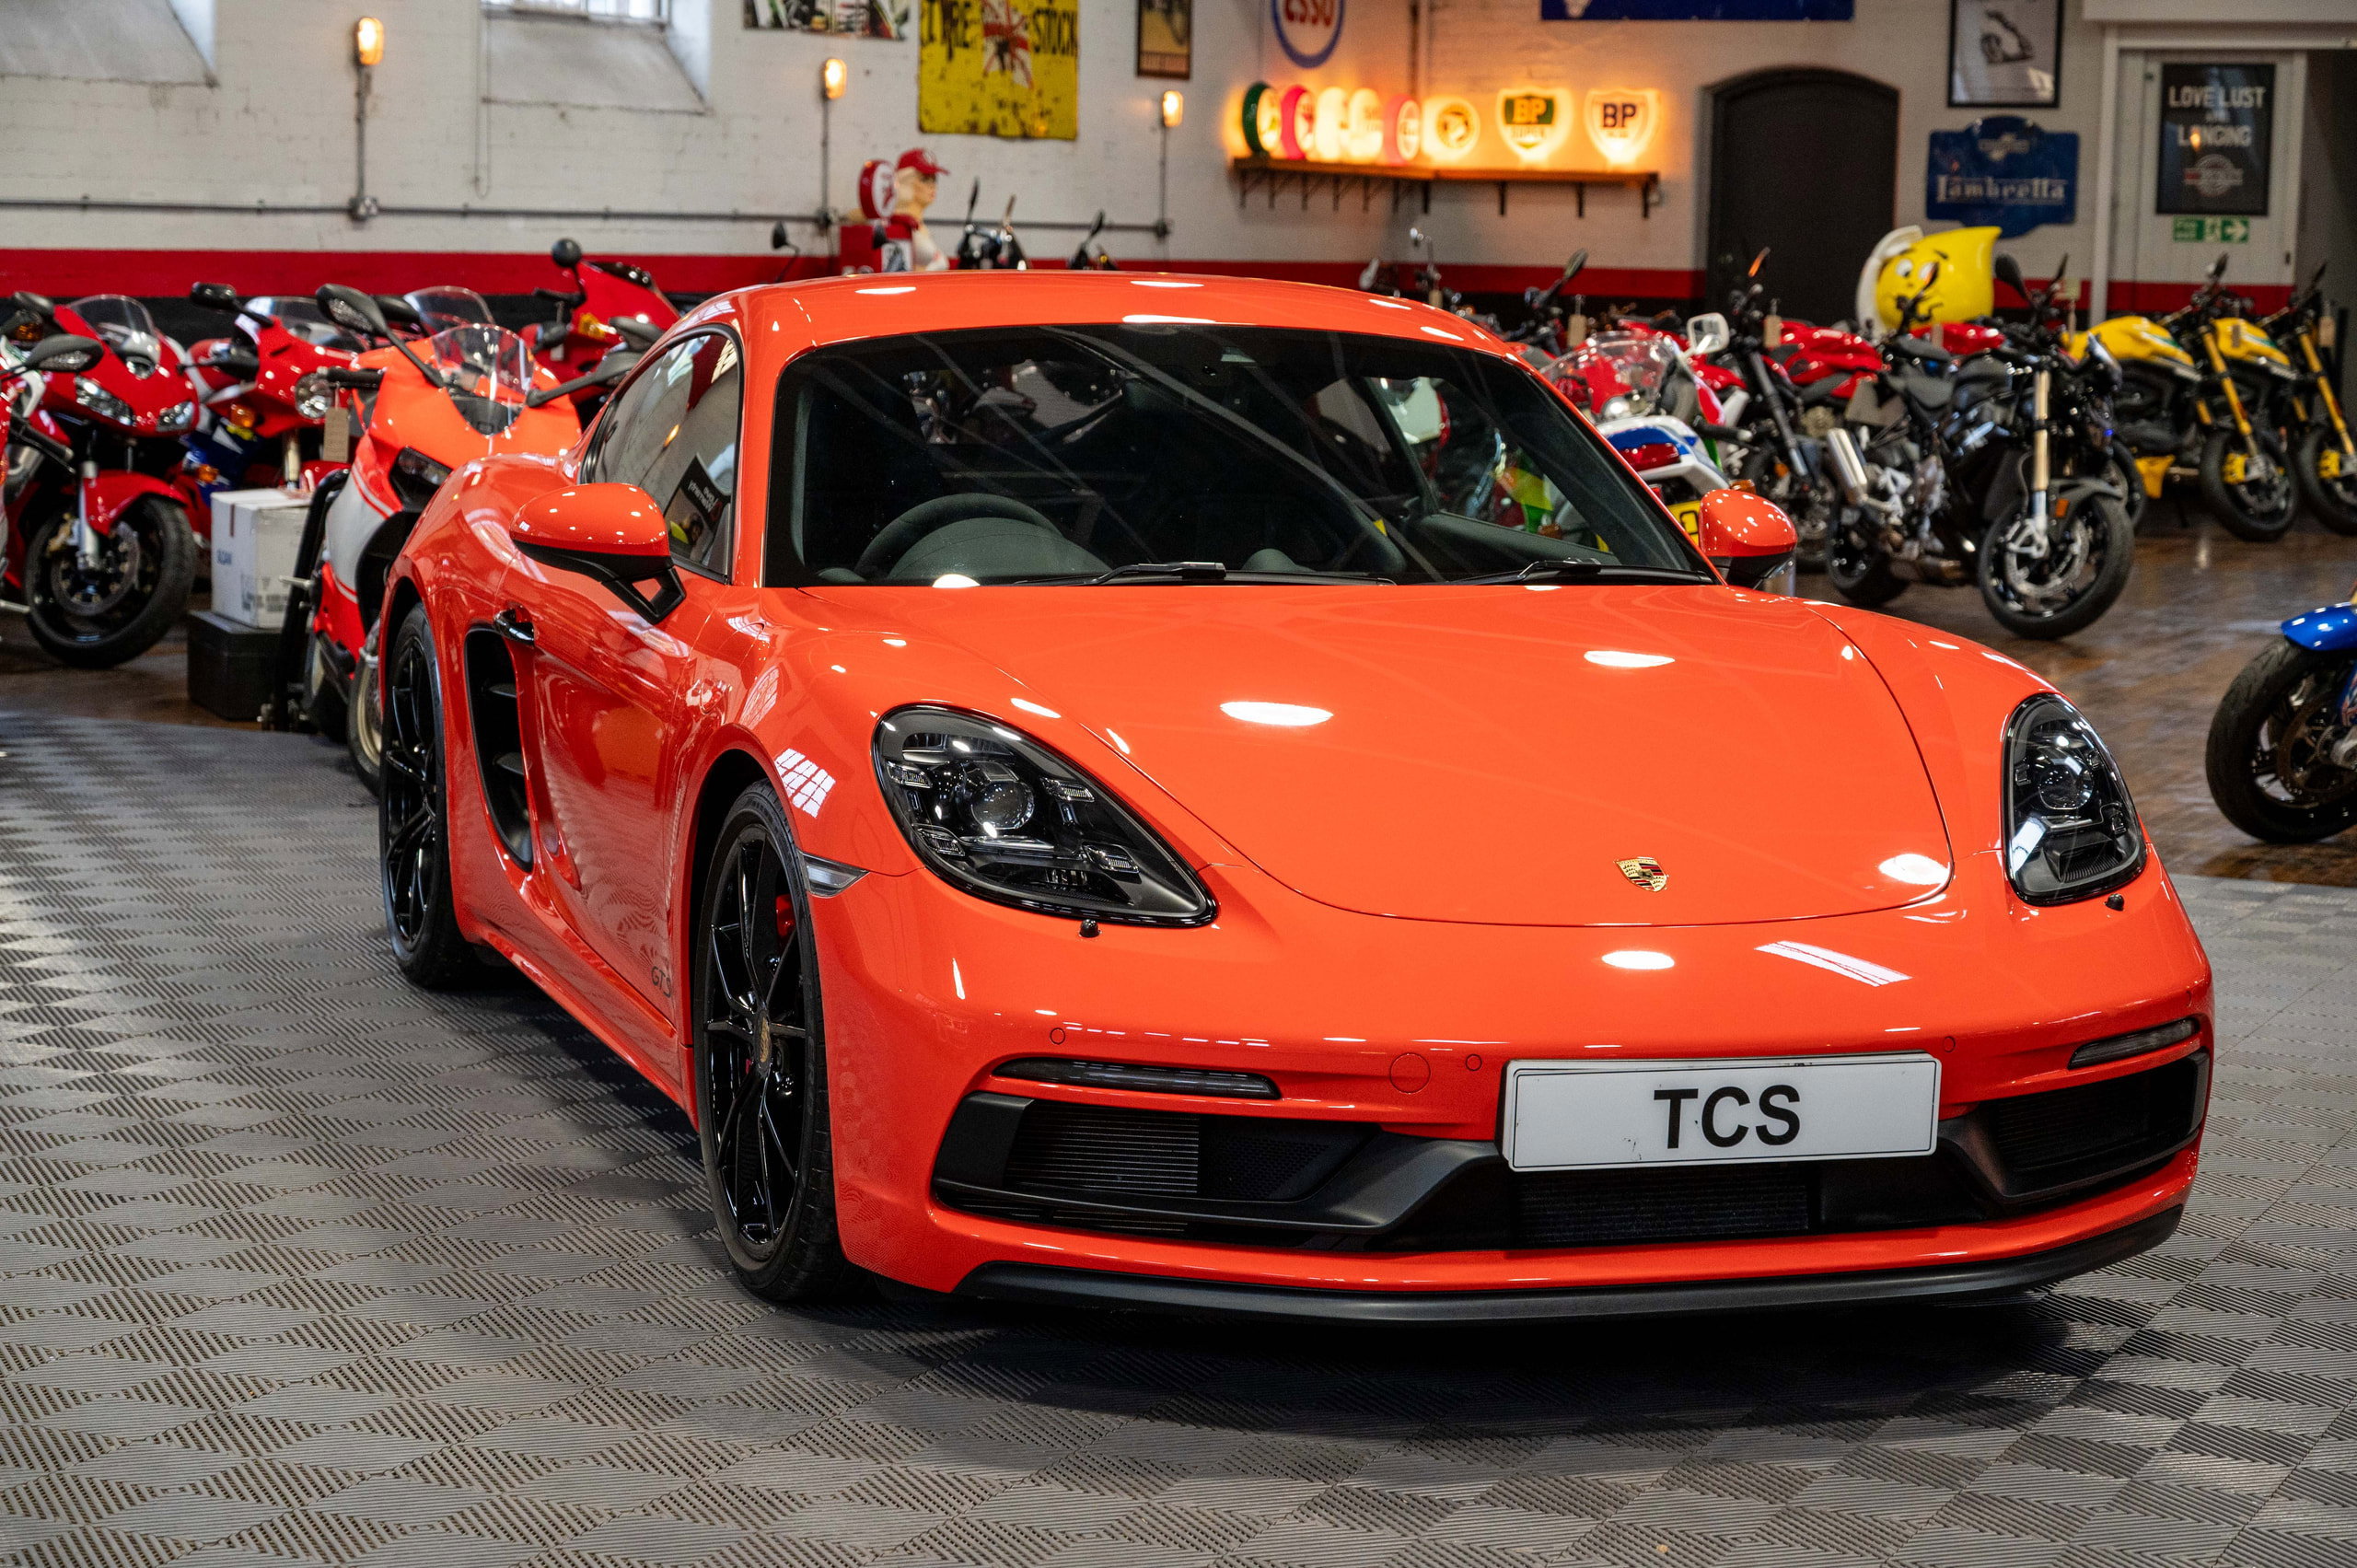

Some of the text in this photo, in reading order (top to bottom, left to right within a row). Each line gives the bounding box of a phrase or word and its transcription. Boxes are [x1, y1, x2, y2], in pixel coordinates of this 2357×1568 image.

[2168, 85, 2266, 110] LOVE LUST
[1512, 98, 1548, 125] BP
[1603, 103, 1637, 129] BP
[1654, 1084, 1801, 1149] TCS
